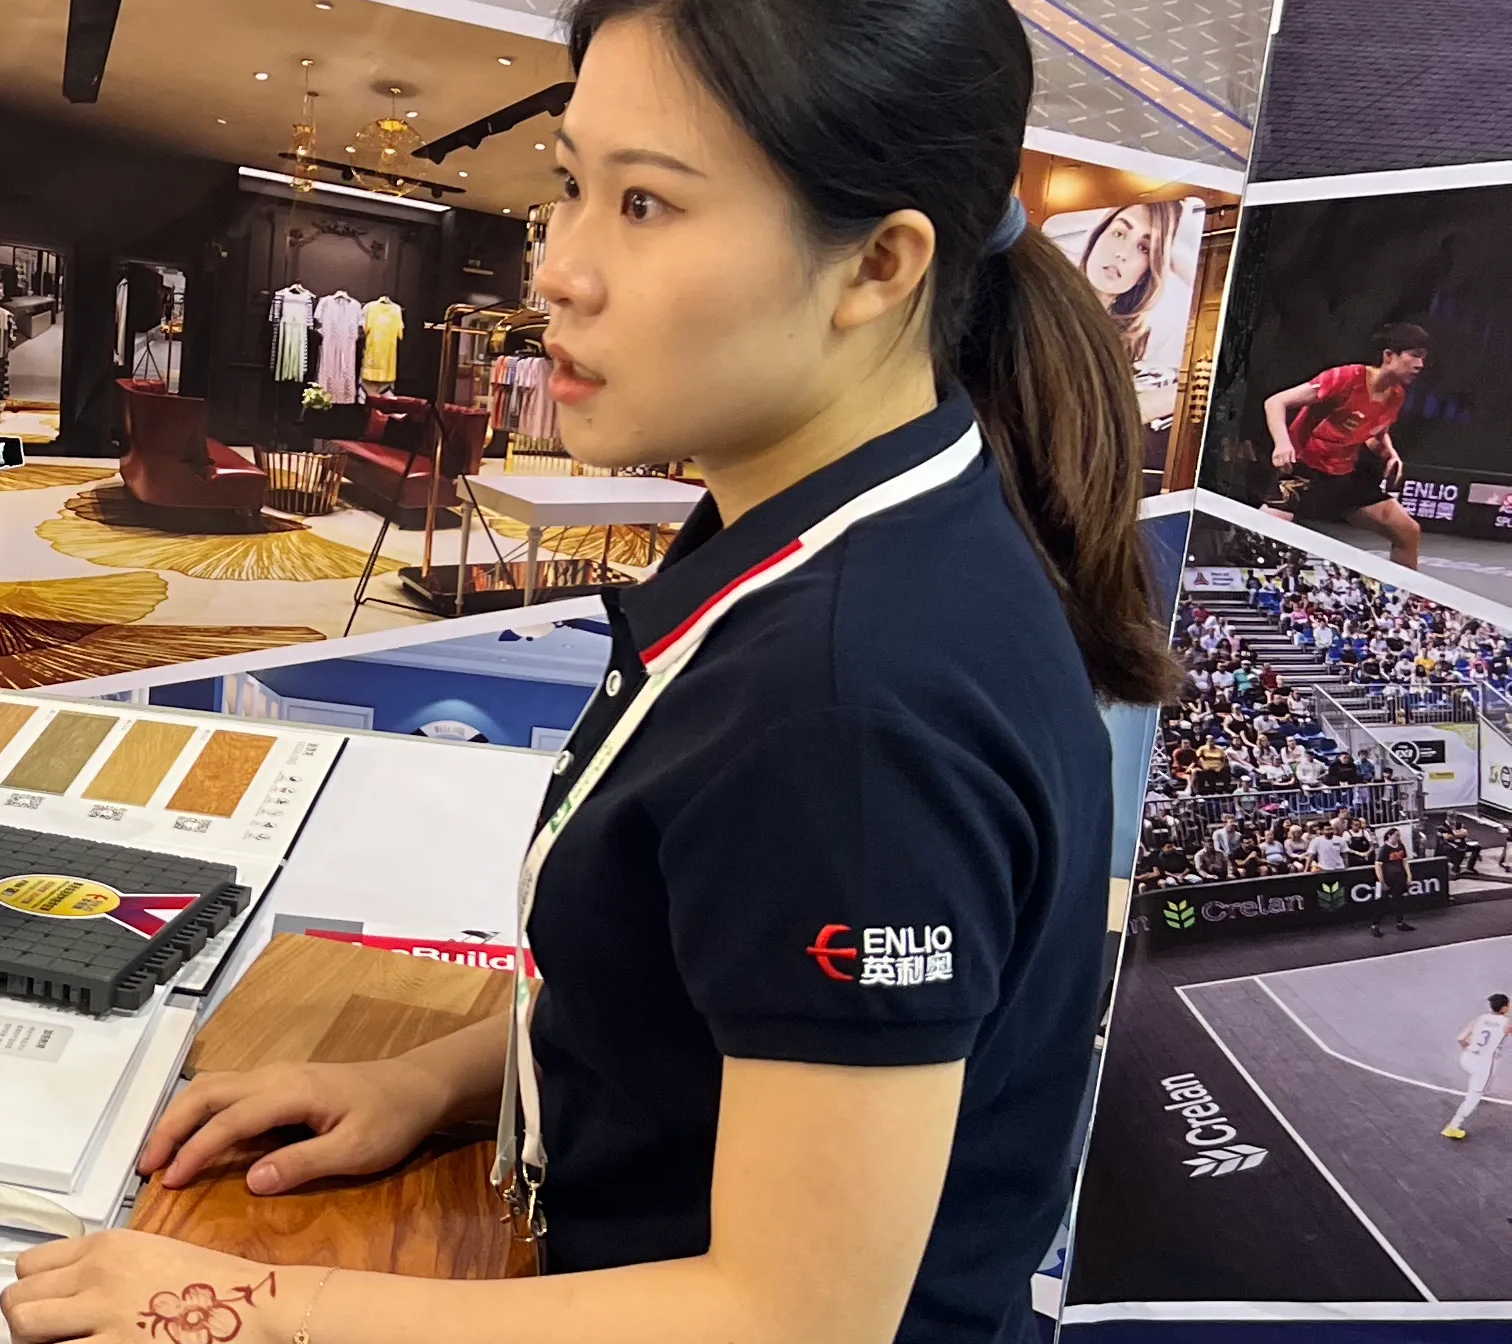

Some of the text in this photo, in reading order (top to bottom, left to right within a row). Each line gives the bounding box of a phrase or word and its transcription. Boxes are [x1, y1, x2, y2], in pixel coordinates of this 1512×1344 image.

[1401, 480, 1459, 502] ENLIO
[1201, 892, 1305, 923] Crelan
[863, 925, 953, 956] ENLIO
[859, 951, 954, 987] 英利奥
[1476, 1029, 1491, 1047] 3
[1160, 1072, 1237, 1146] Crelan
